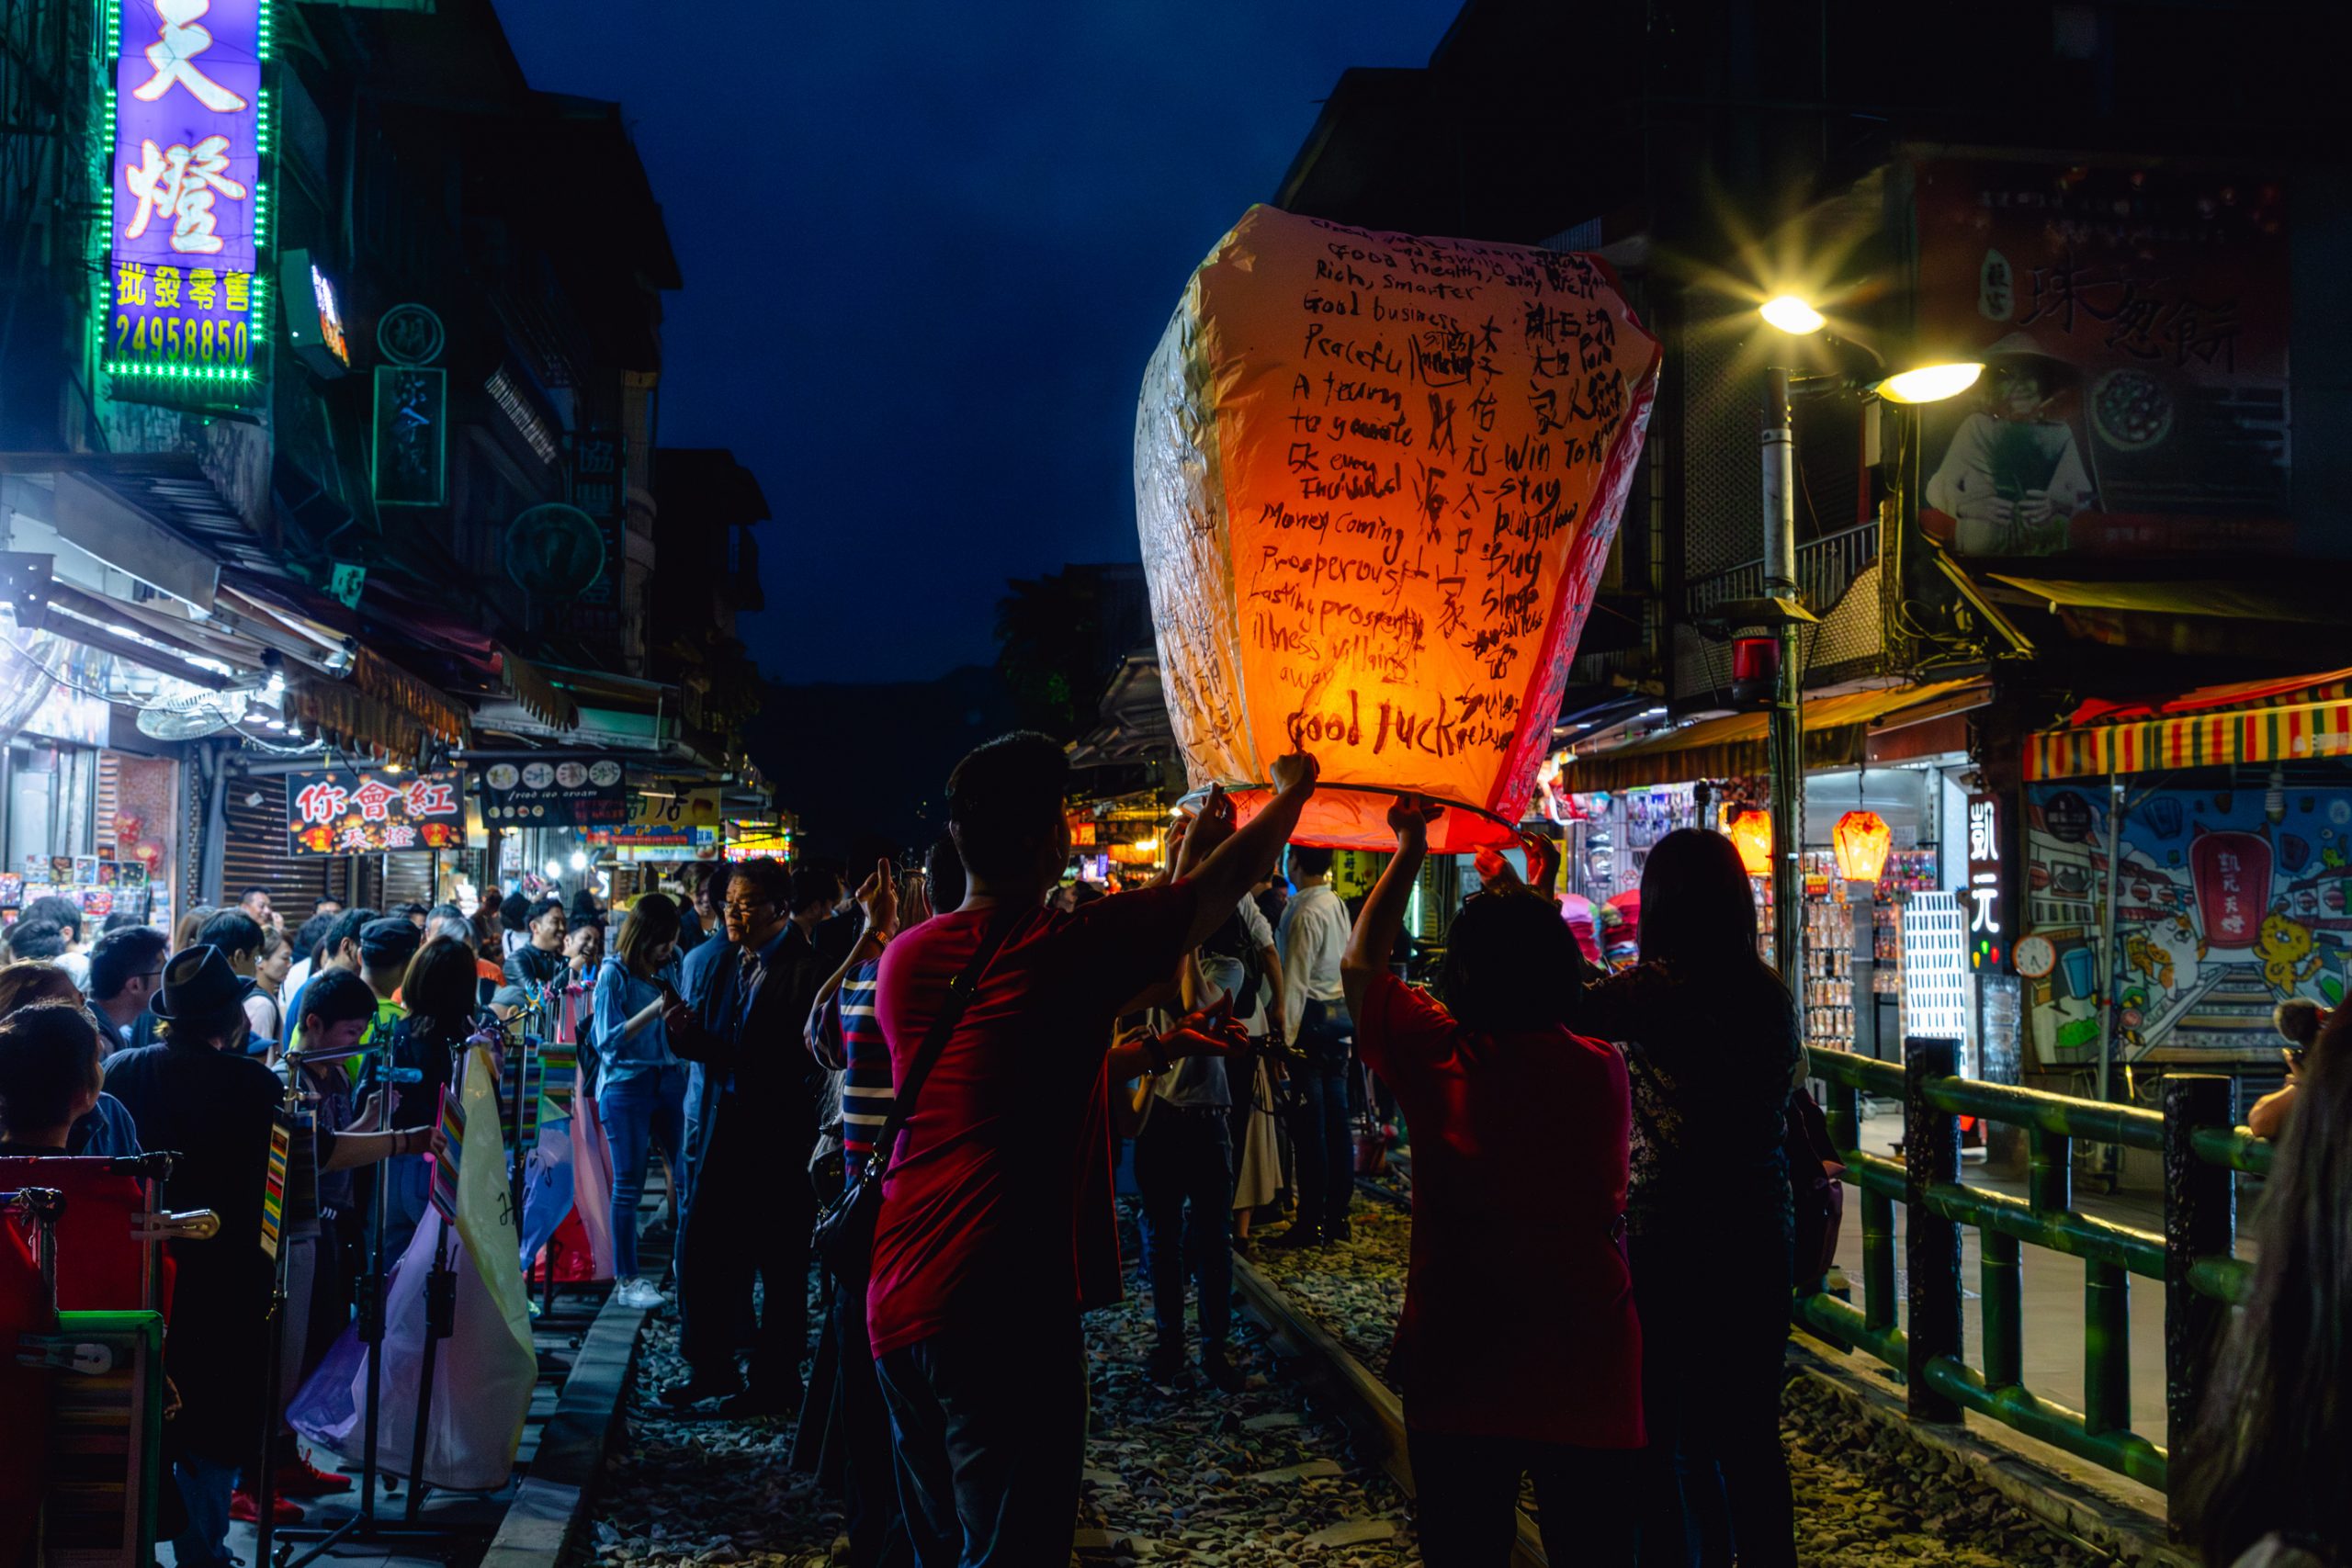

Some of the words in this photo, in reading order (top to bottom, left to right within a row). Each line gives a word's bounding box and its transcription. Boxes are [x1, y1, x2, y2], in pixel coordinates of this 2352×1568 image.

[117, 262, 251, 311] 批發零售
[116, 314, 248, 363] 24958850
[1293, 372, 1310, 400] A
[296, 780, 458, 824] 你會紅
[341, 825, 415, 850] 天燈
